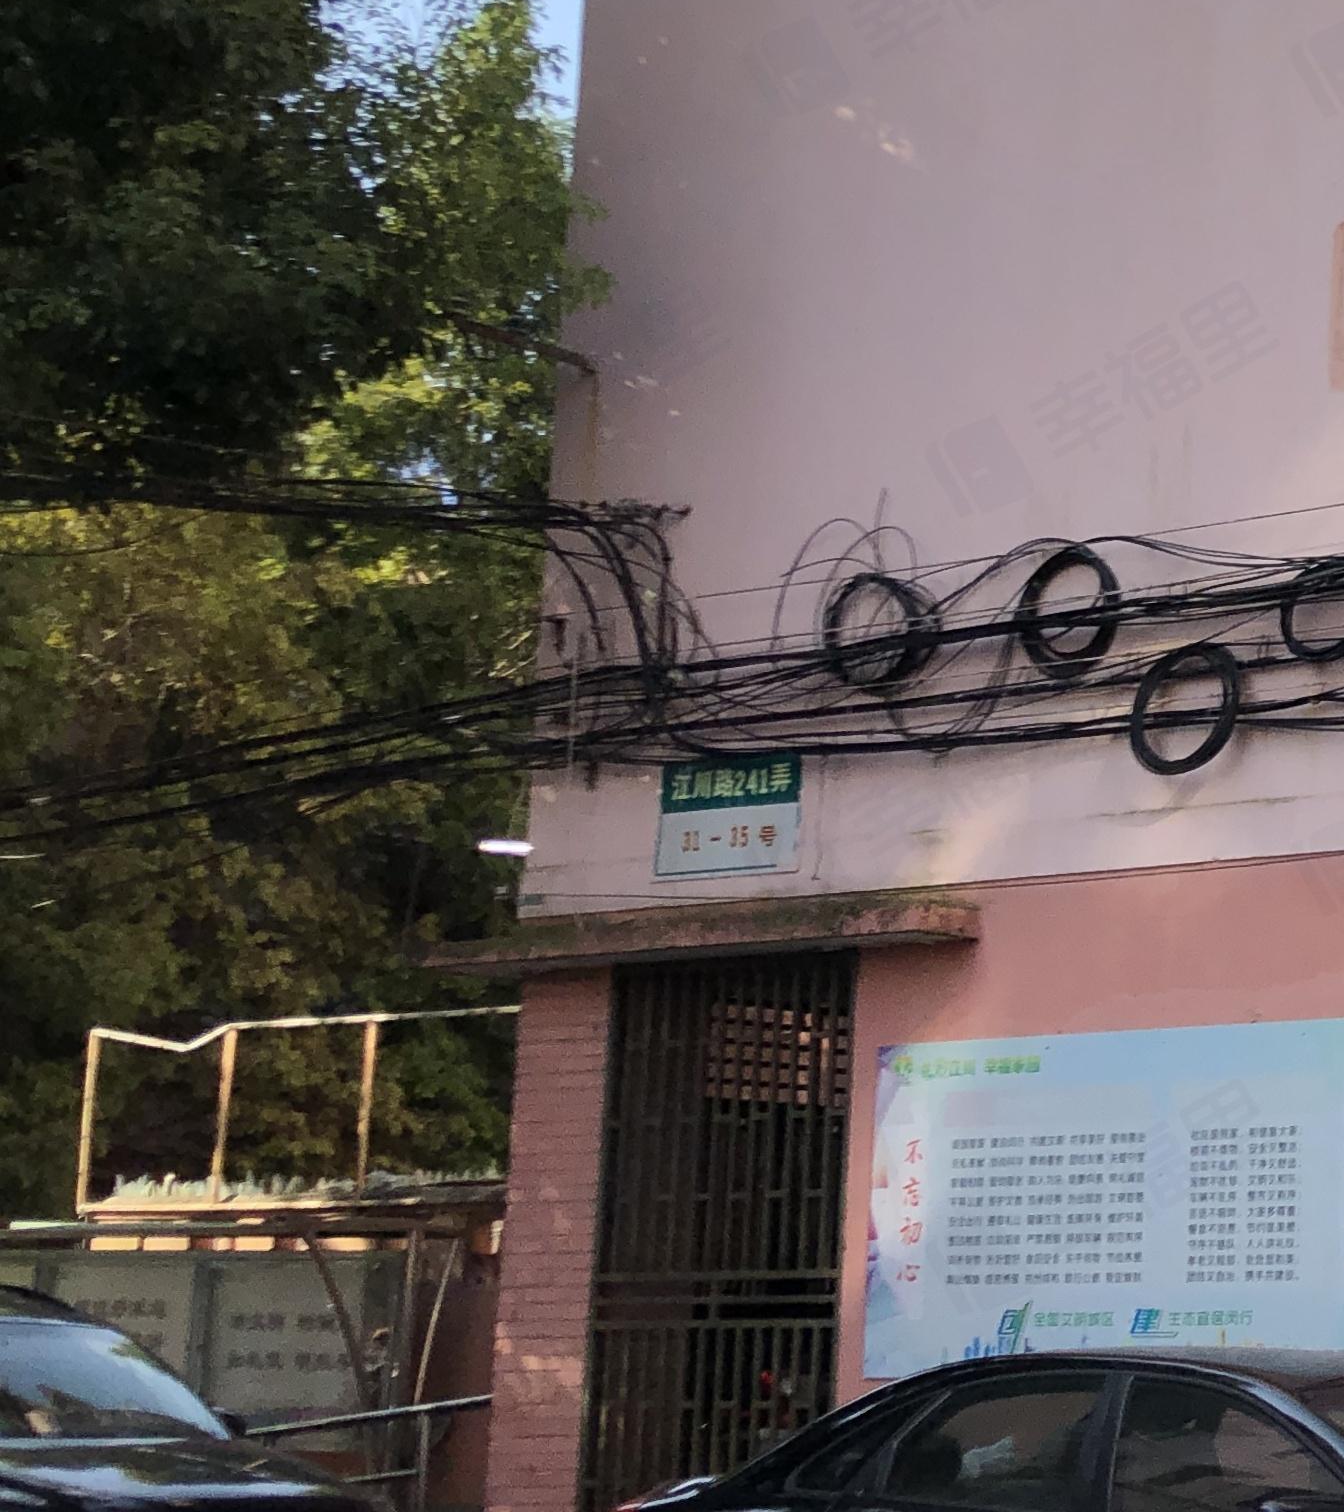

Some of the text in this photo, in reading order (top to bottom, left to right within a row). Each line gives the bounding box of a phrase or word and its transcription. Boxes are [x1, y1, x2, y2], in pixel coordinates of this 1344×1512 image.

[671, 762, 792, 801] 江川路241弄
[897, 1139, 924, 1282] 不忘初心
